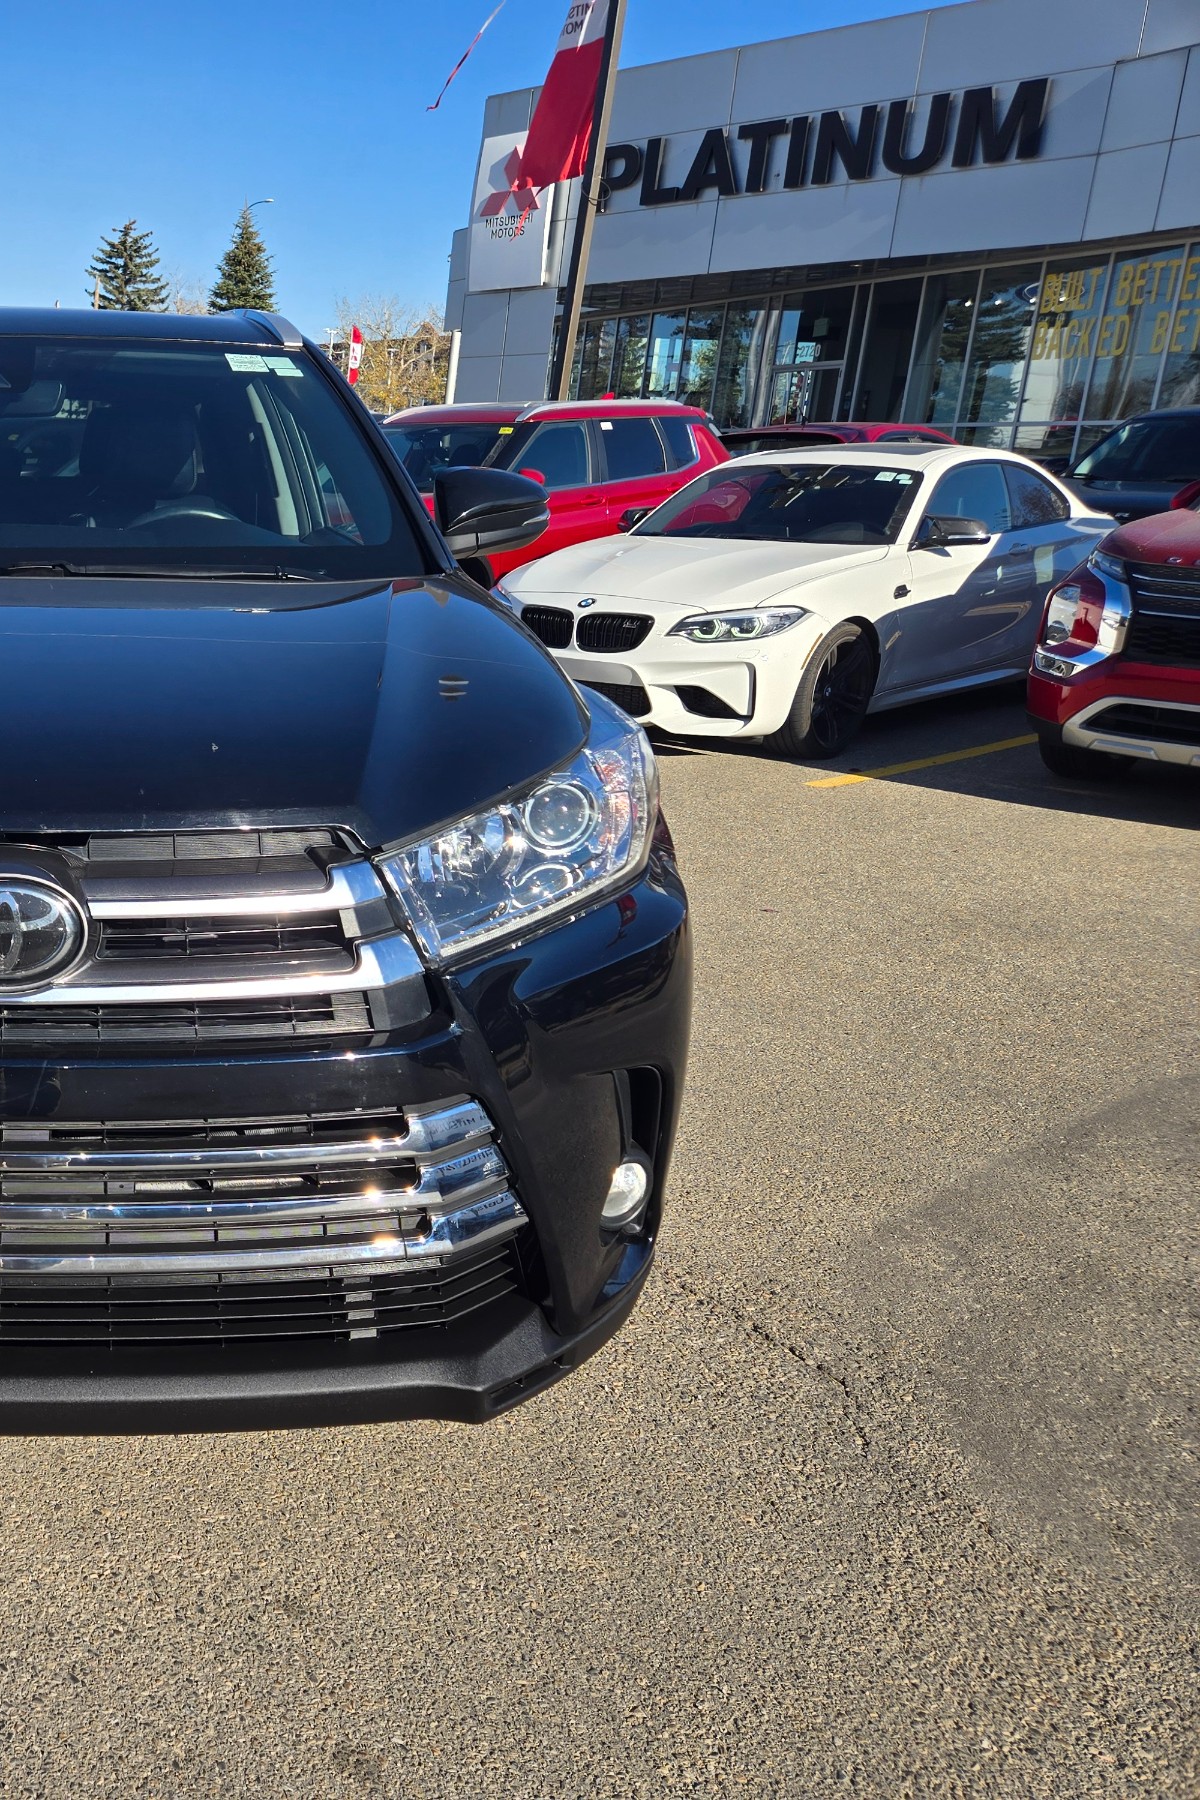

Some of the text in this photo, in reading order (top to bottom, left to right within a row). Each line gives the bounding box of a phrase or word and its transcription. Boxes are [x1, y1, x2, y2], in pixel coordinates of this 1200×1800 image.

[598, 78, 1052, 212] PLATINUM
[491, 226, 525, 239] MOTORS
[1040, 257, 1200, 314] BUILT BETTE
[799, 344, 821, 358] 2720
[1030, 314, 1130, 361] BACKED
